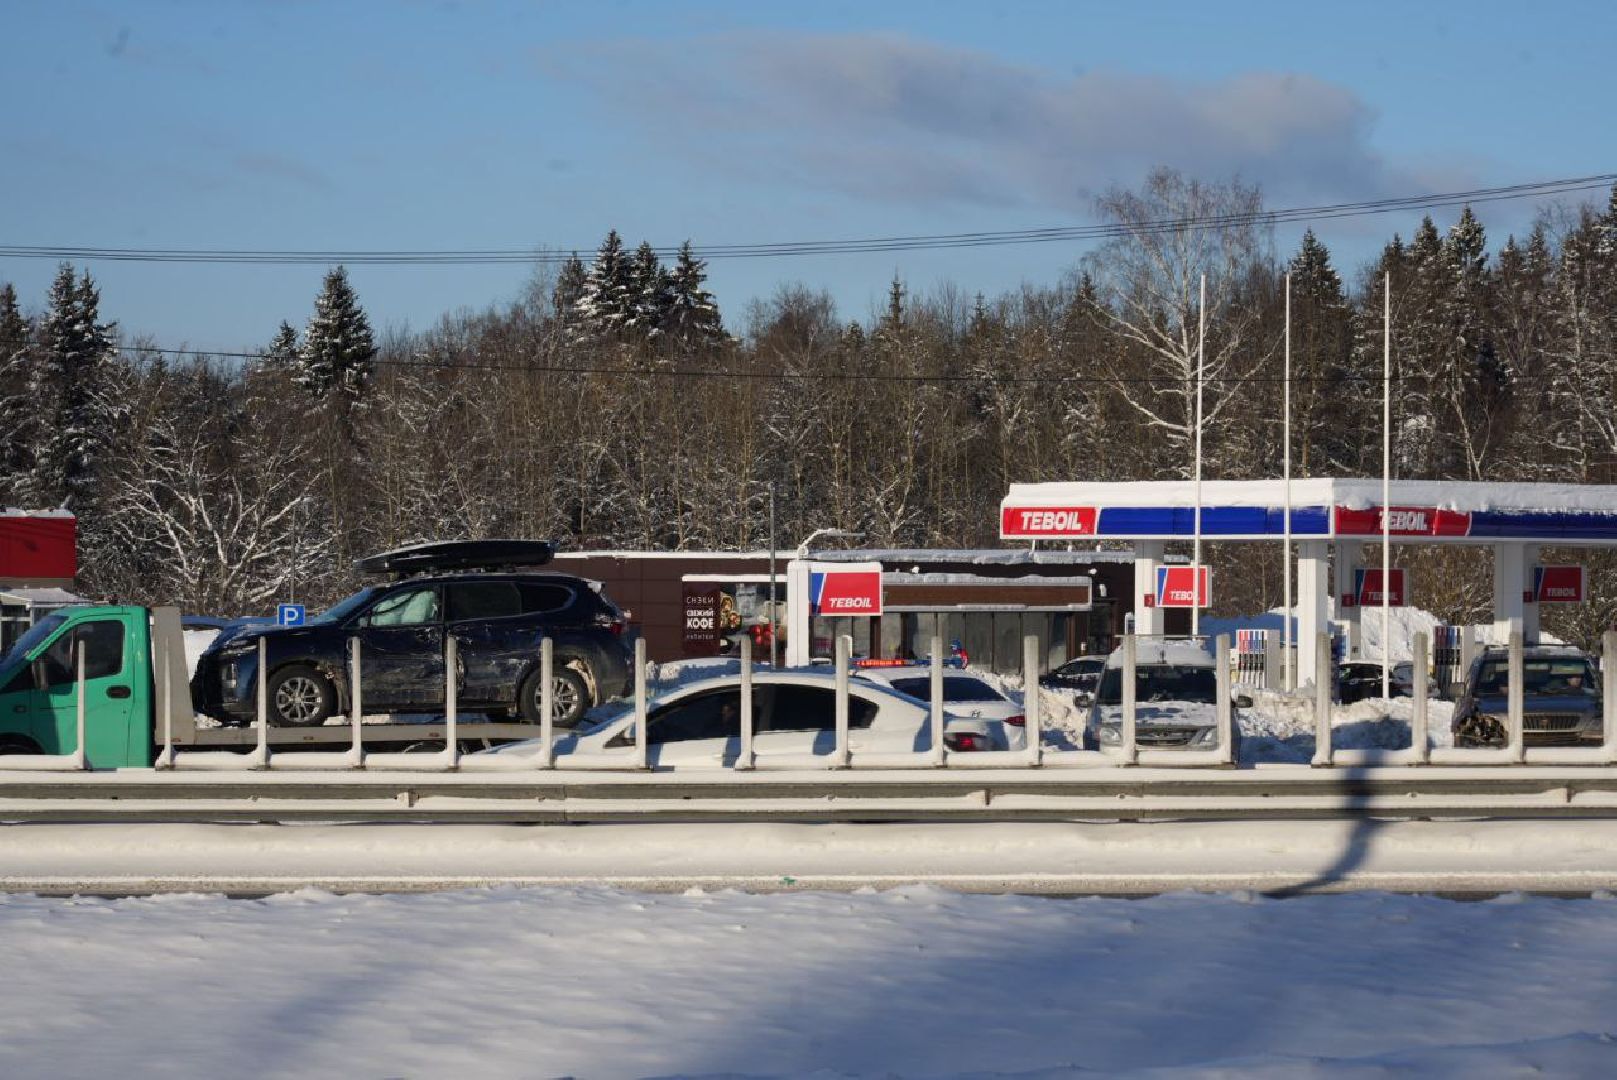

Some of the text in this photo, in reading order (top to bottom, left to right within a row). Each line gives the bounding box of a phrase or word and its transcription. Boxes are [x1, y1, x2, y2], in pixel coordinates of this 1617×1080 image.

[1021, 511, 1082, 531] TEBOIL
[686, 596, 714, 604] СНЭКИ
[1169, 590, 1194, 601] TEBO
[829, 597, 872, 608] TEBOIL
[284, 607, 299, 626] P
[686, 617, 714, 630] КОФЕ
